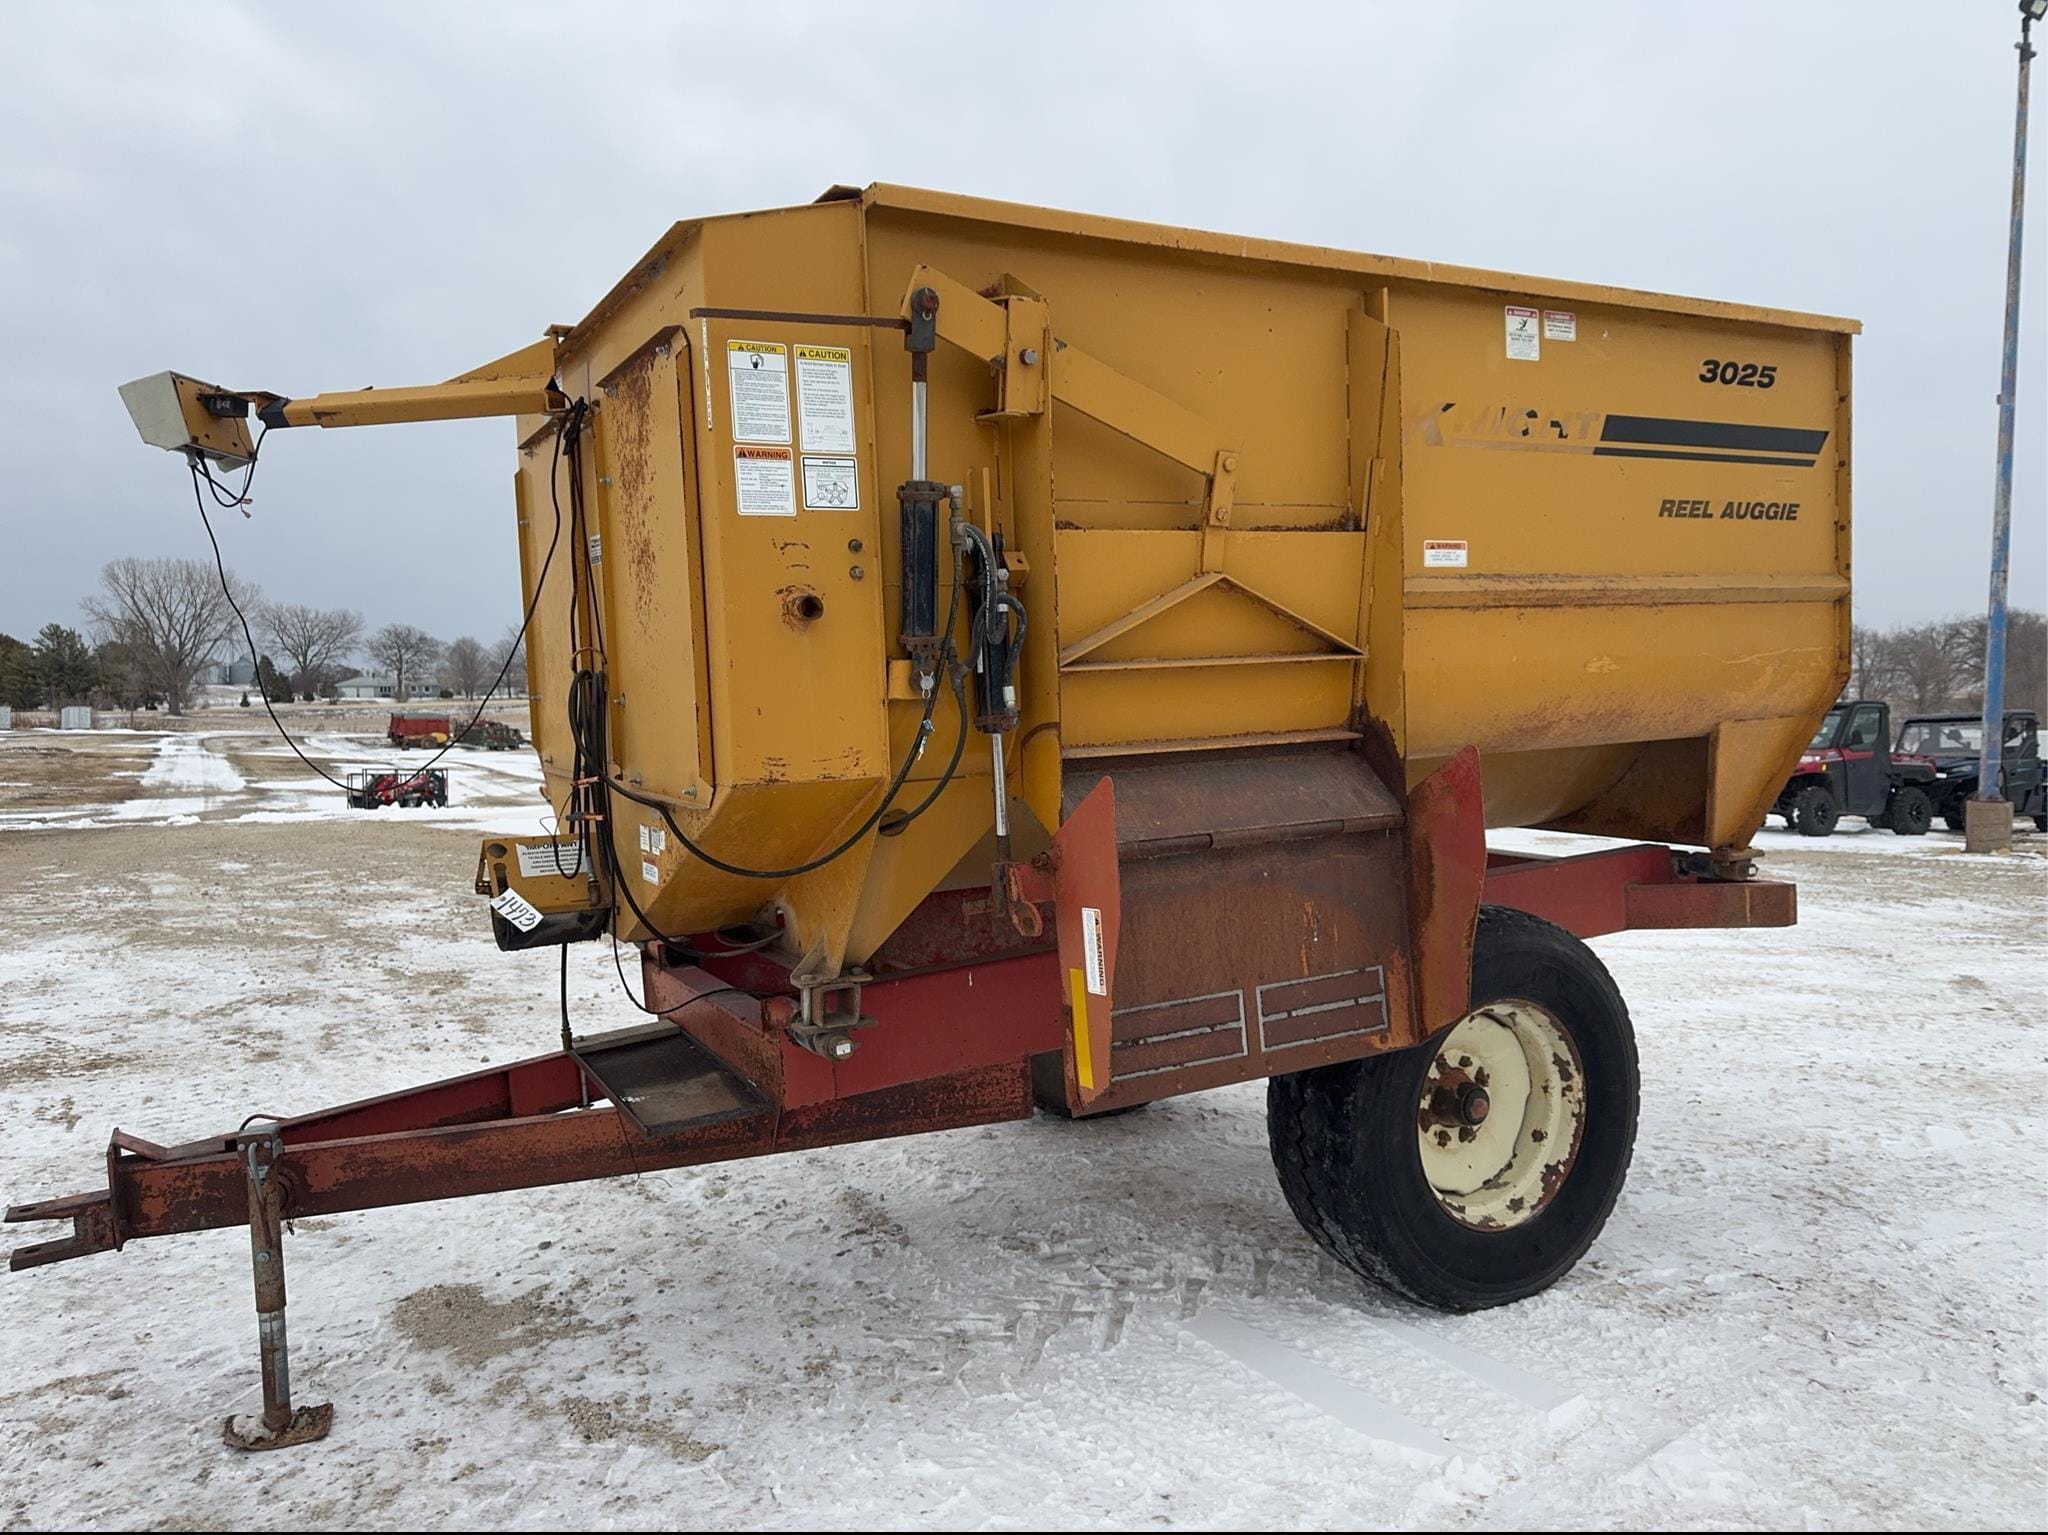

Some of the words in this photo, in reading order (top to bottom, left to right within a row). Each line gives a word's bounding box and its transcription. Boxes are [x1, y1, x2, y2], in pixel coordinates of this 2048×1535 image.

[746, 344, 777, 353] CAUTION
[808, 349, 847, 360] CAUTION
[1699, 359, 1777, 389] 3025
[747, 449, 788, 459] WARNING
[1658, 499, 1713, 519] REEL
[1720, 502, 1800, 521] AUGGIE
[526, 841, 578, 851] IMPOANT
[497, 896, 536, 927] 1473
